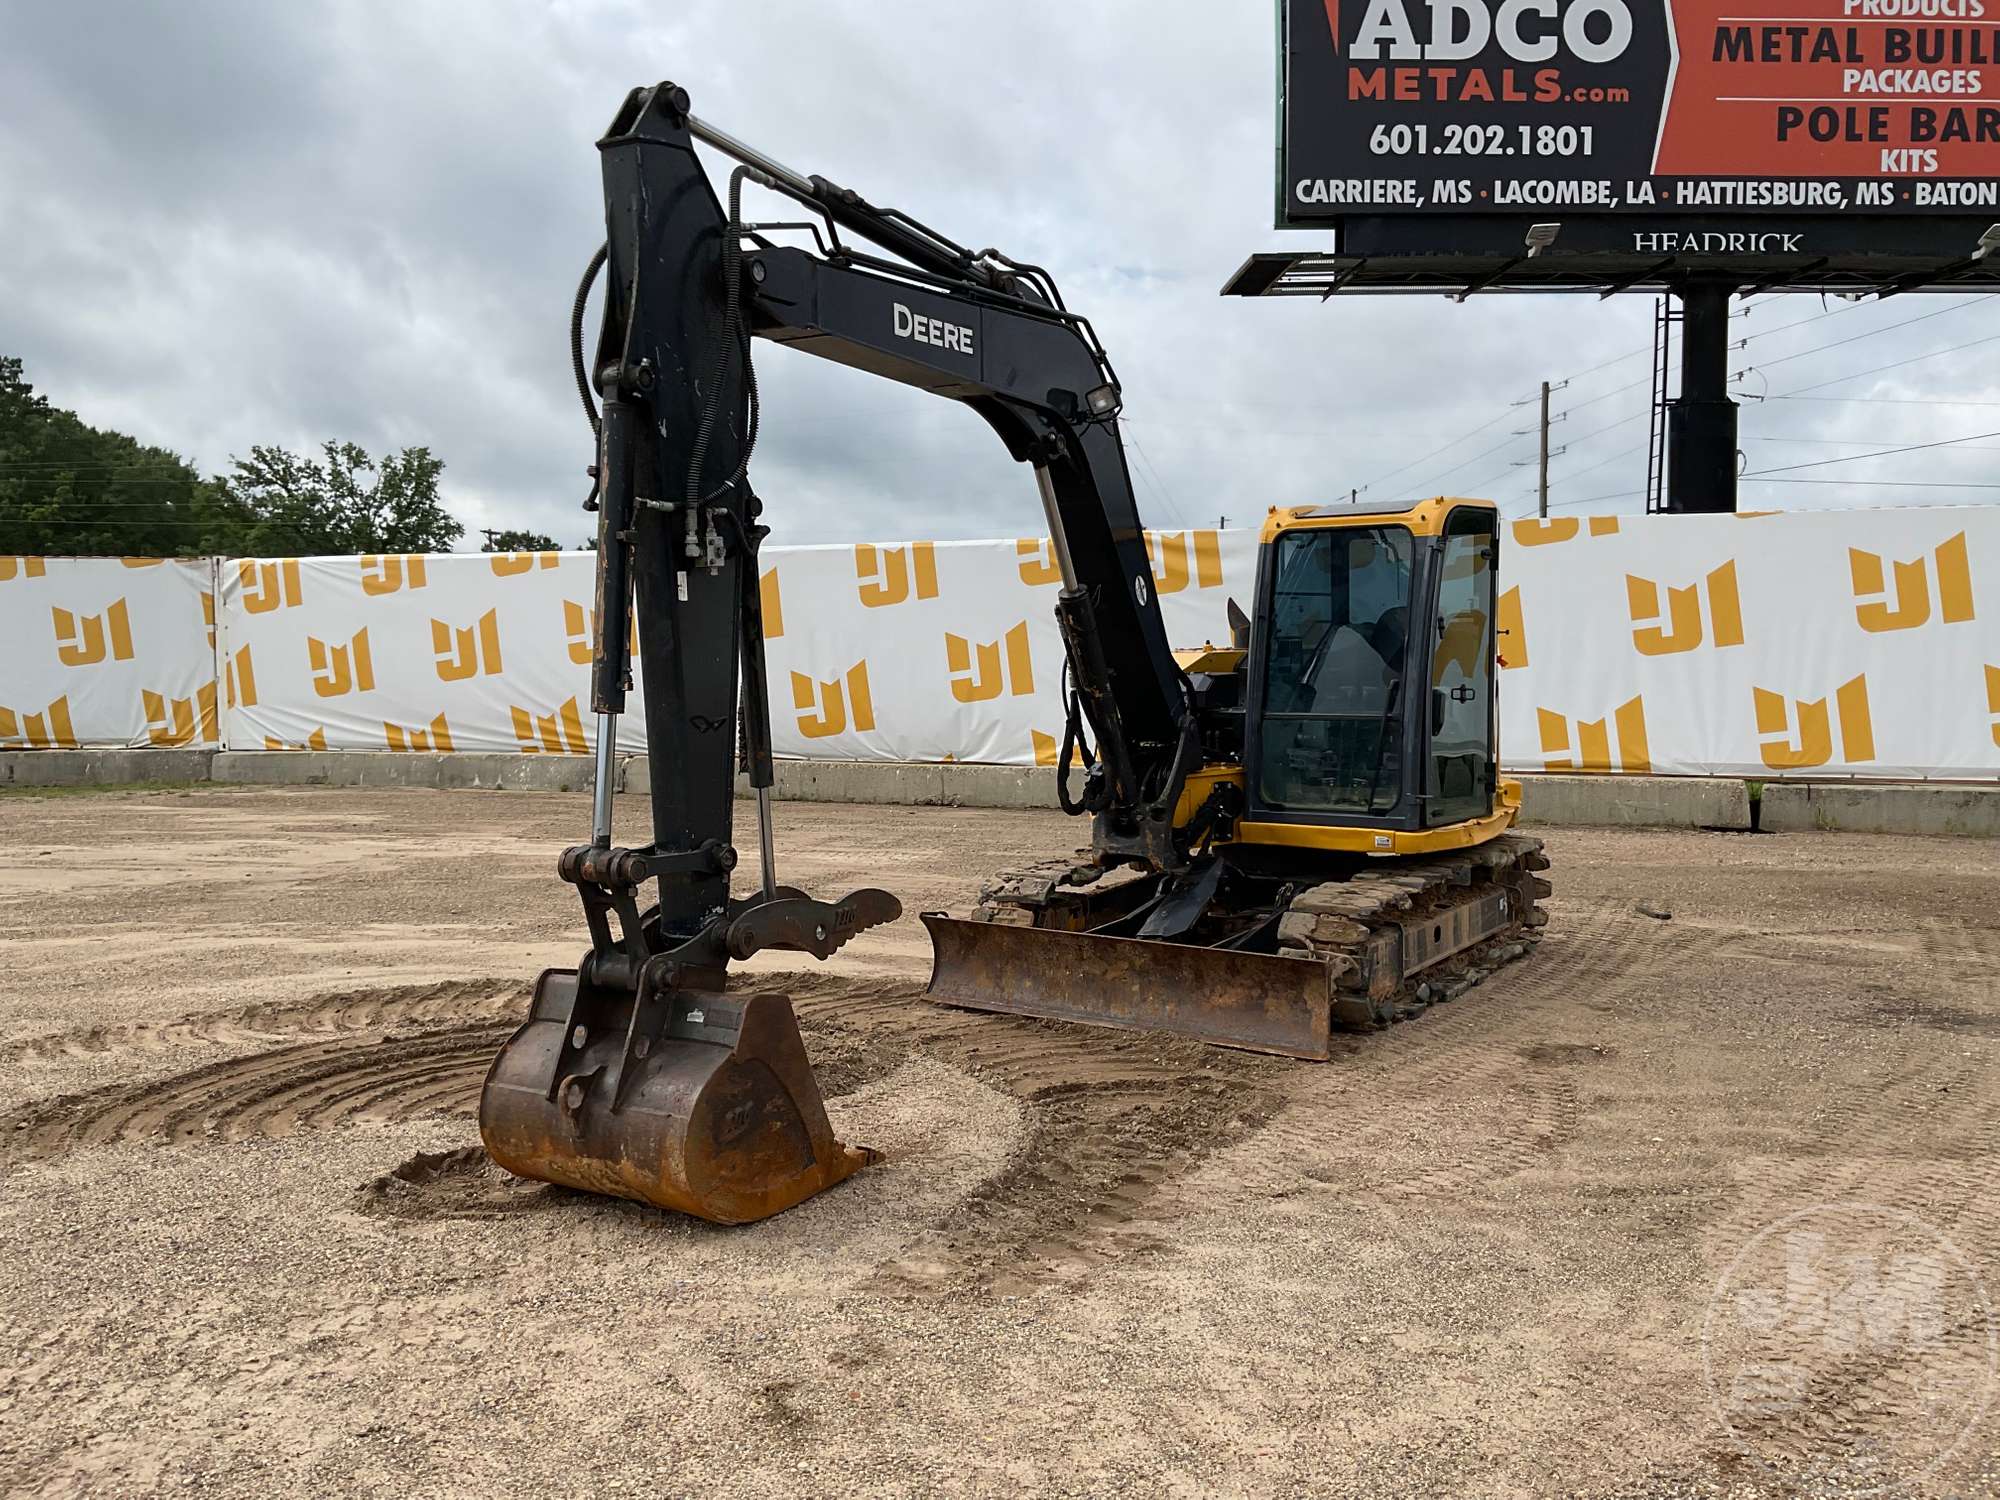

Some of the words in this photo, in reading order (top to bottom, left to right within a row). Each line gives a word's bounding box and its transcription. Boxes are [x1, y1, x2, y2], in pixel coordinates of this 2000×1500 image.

[1843, 0, 1985, 17] PRODUCTS
[1349, 0, 1633, 63] ADCO
[1712, 26, 1865, 64] METAL
[1885, 28, 2000, 65] BUIL
[1843, 69, 1982, 94] PACKAGES
[1777, 106, 1890, 142] POLE
[1369, 124, 1593, 156] 601.202.1801
[1880, 148, 1938, 173] KITS
[1295, 179, 1425, 208] CARRIERE,
[1432, 180, 1473, 204] MS
[1494, 180, 1619, 209] LACOMBE,
[1626, 180, 1656, 204] LA
[1676, 181, 1849, 210] HATTIESBURG,
[1855, 182, 1895, 206] MS
[1915, 182, 1999, 206] BATON
[1633, 232, 1805, 252] HEADRICK
[893, 302, 974, 355] DEERE
